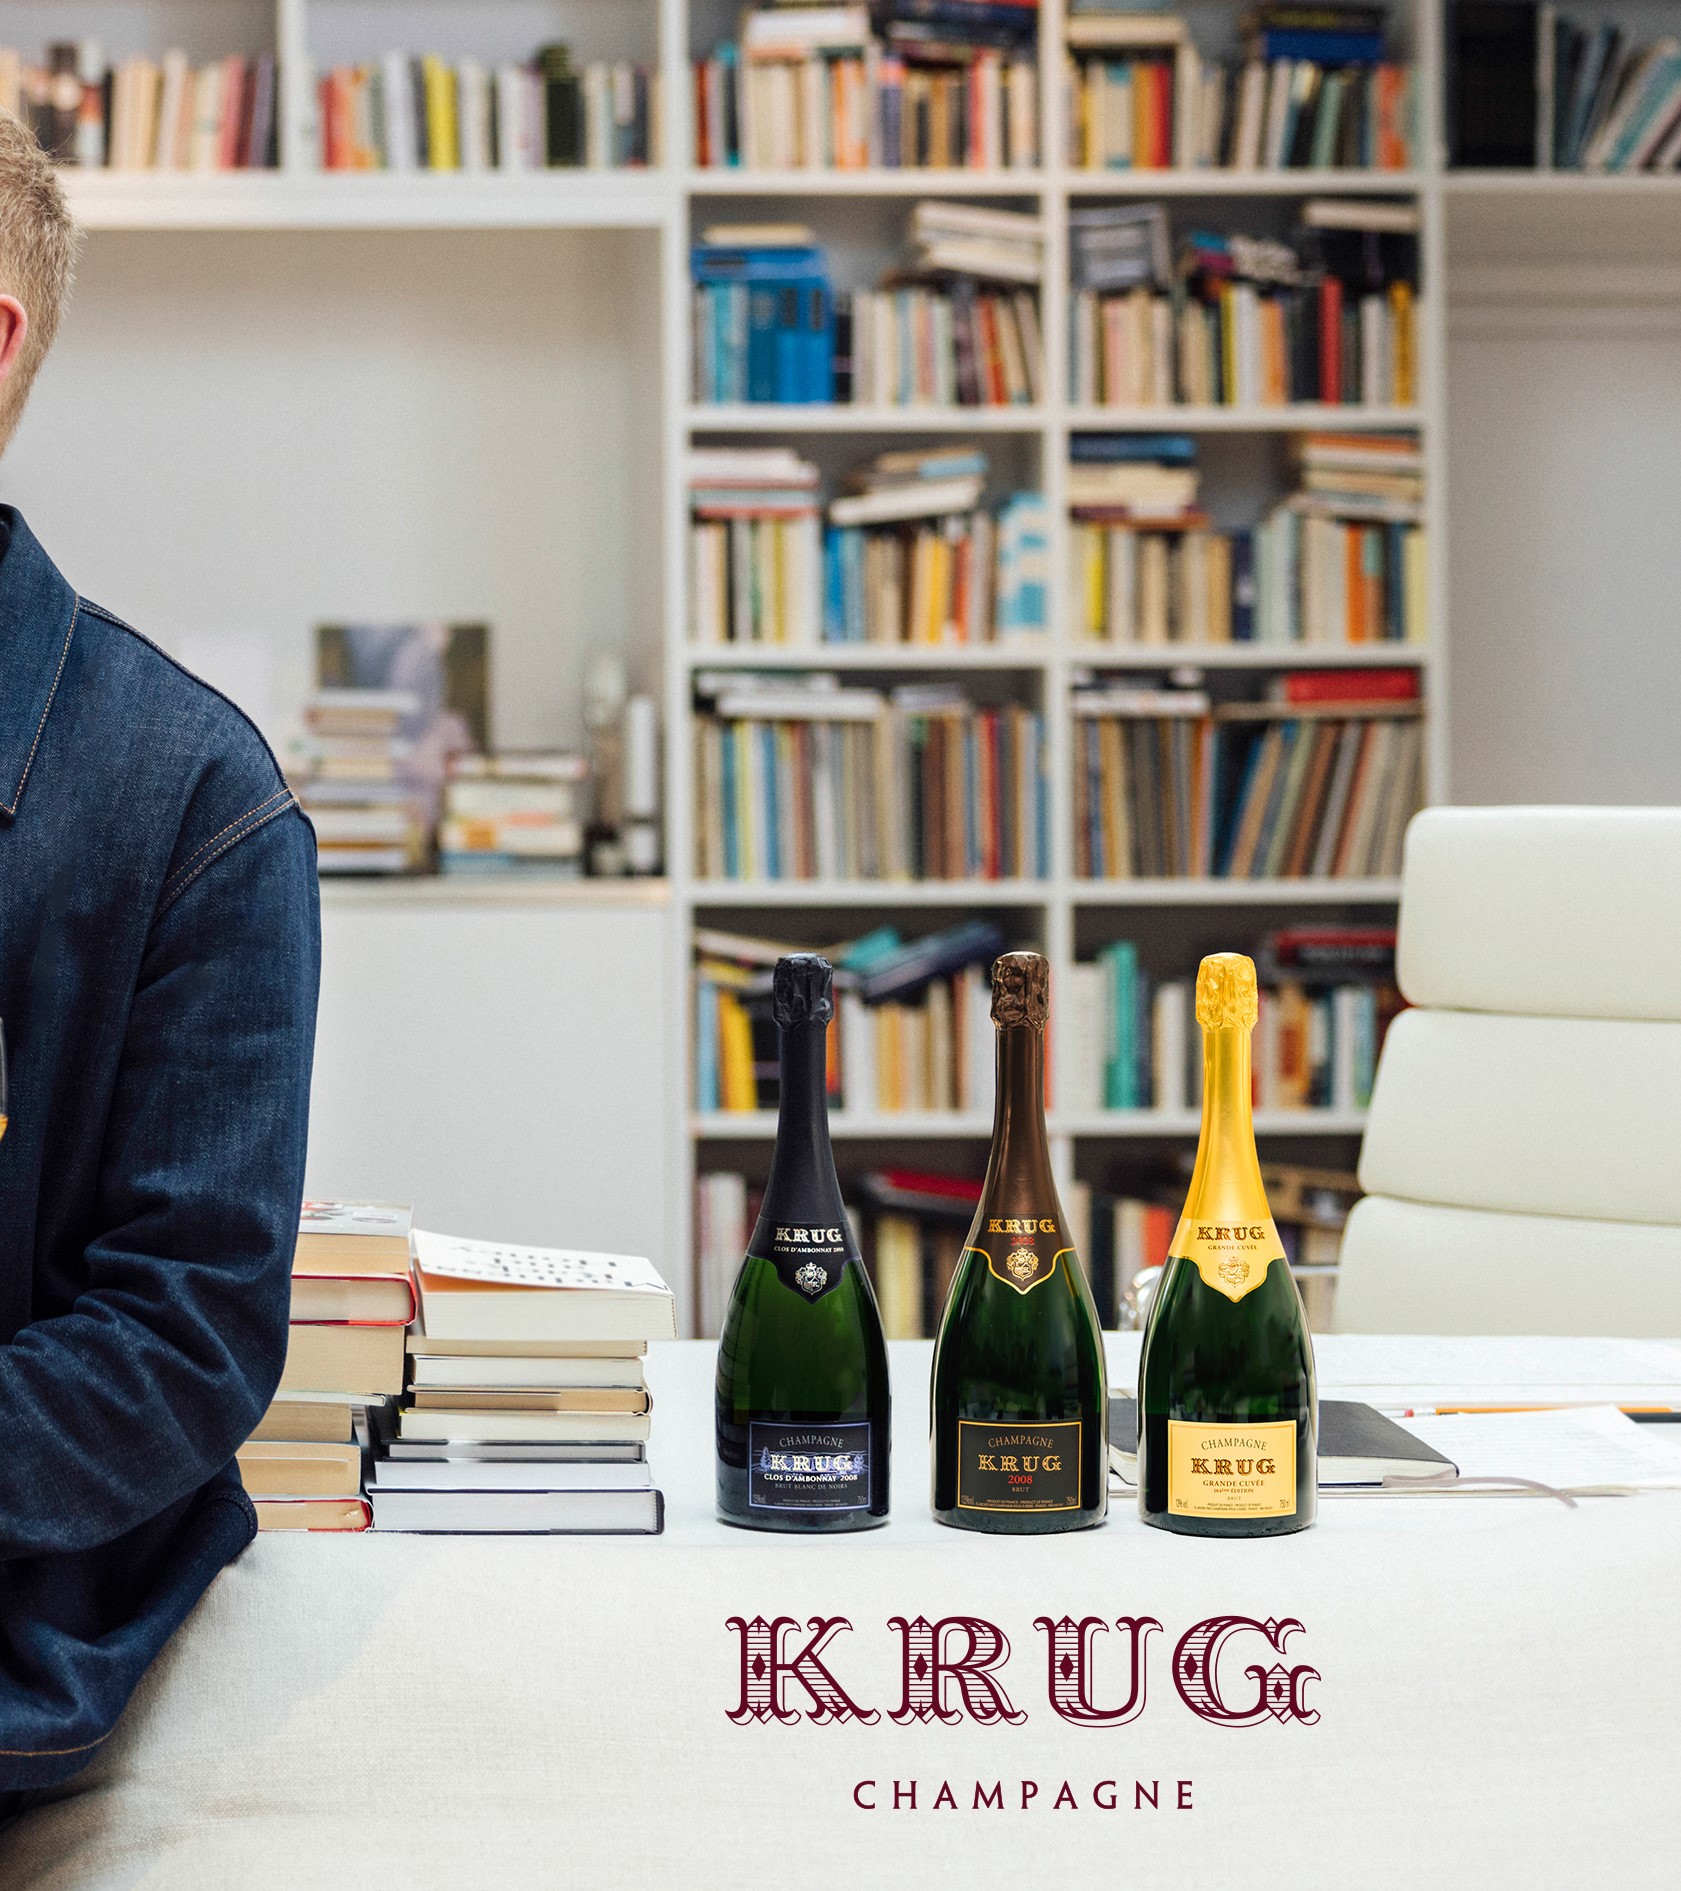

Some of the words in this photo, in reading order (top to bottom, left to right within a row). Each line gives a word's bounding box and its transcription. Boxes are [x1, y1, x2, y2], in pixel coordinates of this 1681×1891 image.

[988, 1219, 1056, 1234] KRUG
[1197, 1226, 1265, 1241] KRUG
[775, 1228, 842, 1243] KRUG
[780, 1435, 844, 1448] CHAMPAGNE
[988, 1435, 1054, 1448] CHAMPAGNE
[1201, 1438, 1267, 1451] CHAMPAGNE
[770, 1454, 854, 1472] KRUG
[978, 1454, 1062, 1472] KRUG
[1191, 1458, 1276, 1476] KRUG
[764, 1473, 783, 1481] CLOS
[785, 1474, 837, 1482] D'AMBONNAY
[1007, 1475, 1033, 1484] 2008
[1239, 1479, 1265, 1487] CUVÉE
